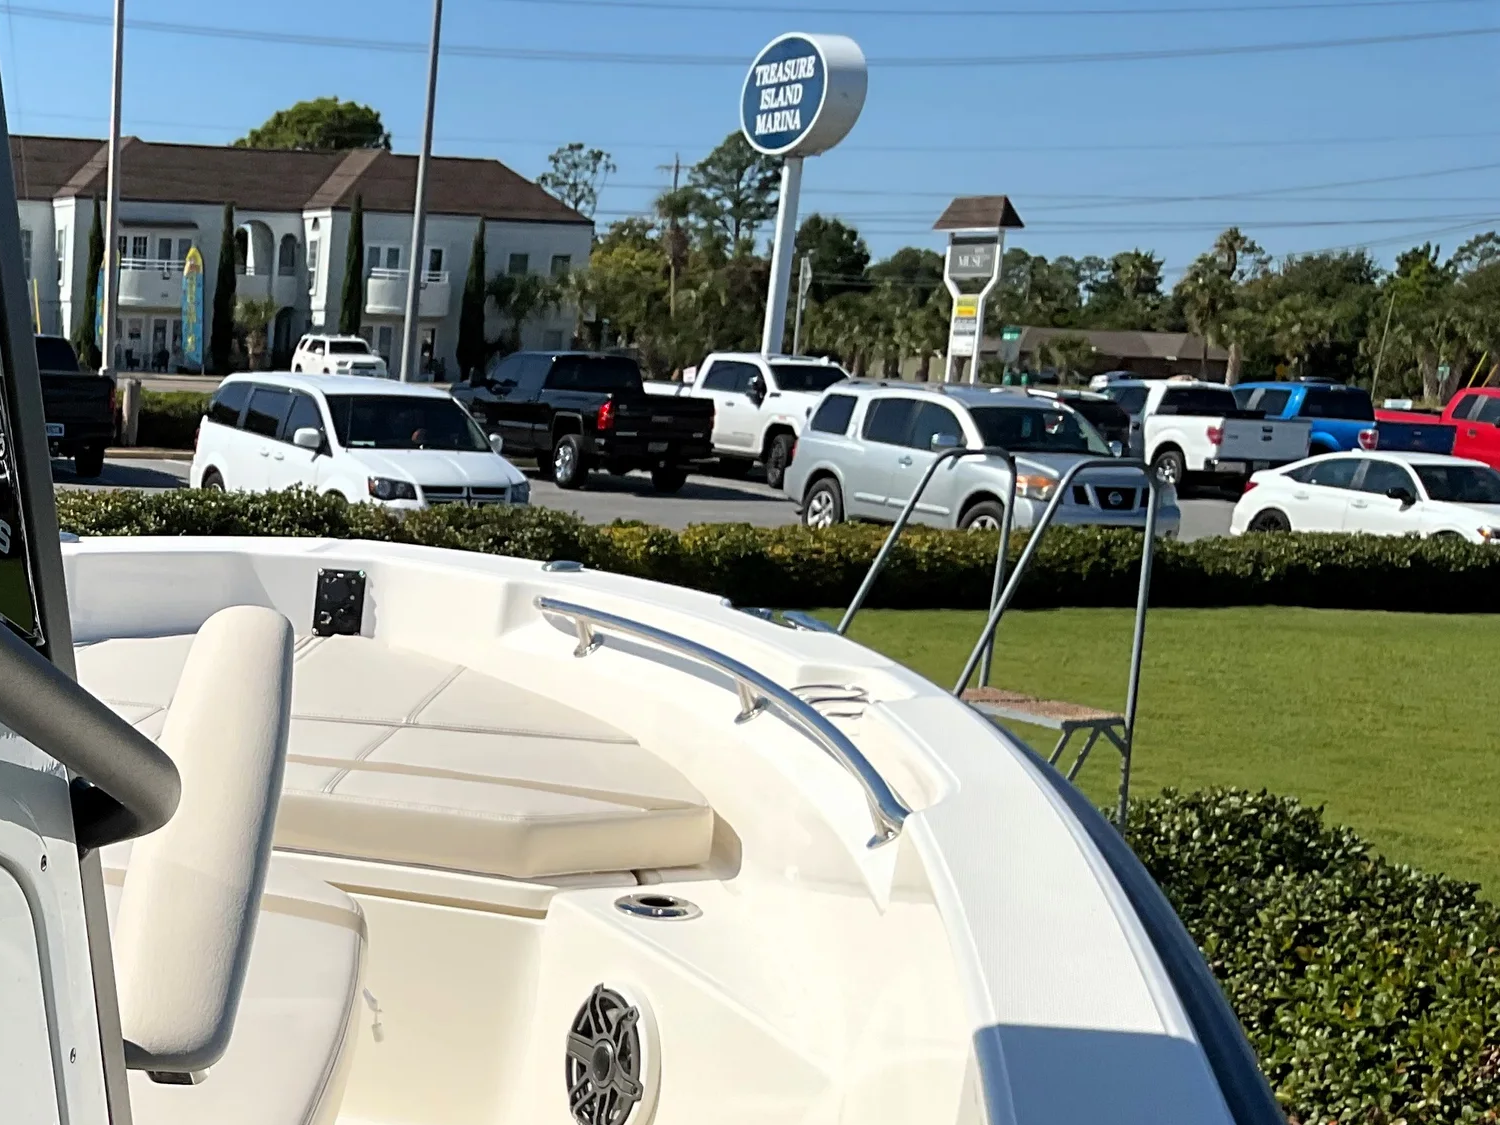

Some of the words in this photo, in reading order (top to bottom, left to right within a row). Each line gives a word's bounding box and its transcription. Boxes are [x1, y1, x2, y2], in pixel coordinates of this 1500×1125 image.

[755, 55, 816, 87] TREASURE
[760, 83, 803, 110] ISLAND
[755, 108, 801, 135] MARINA
